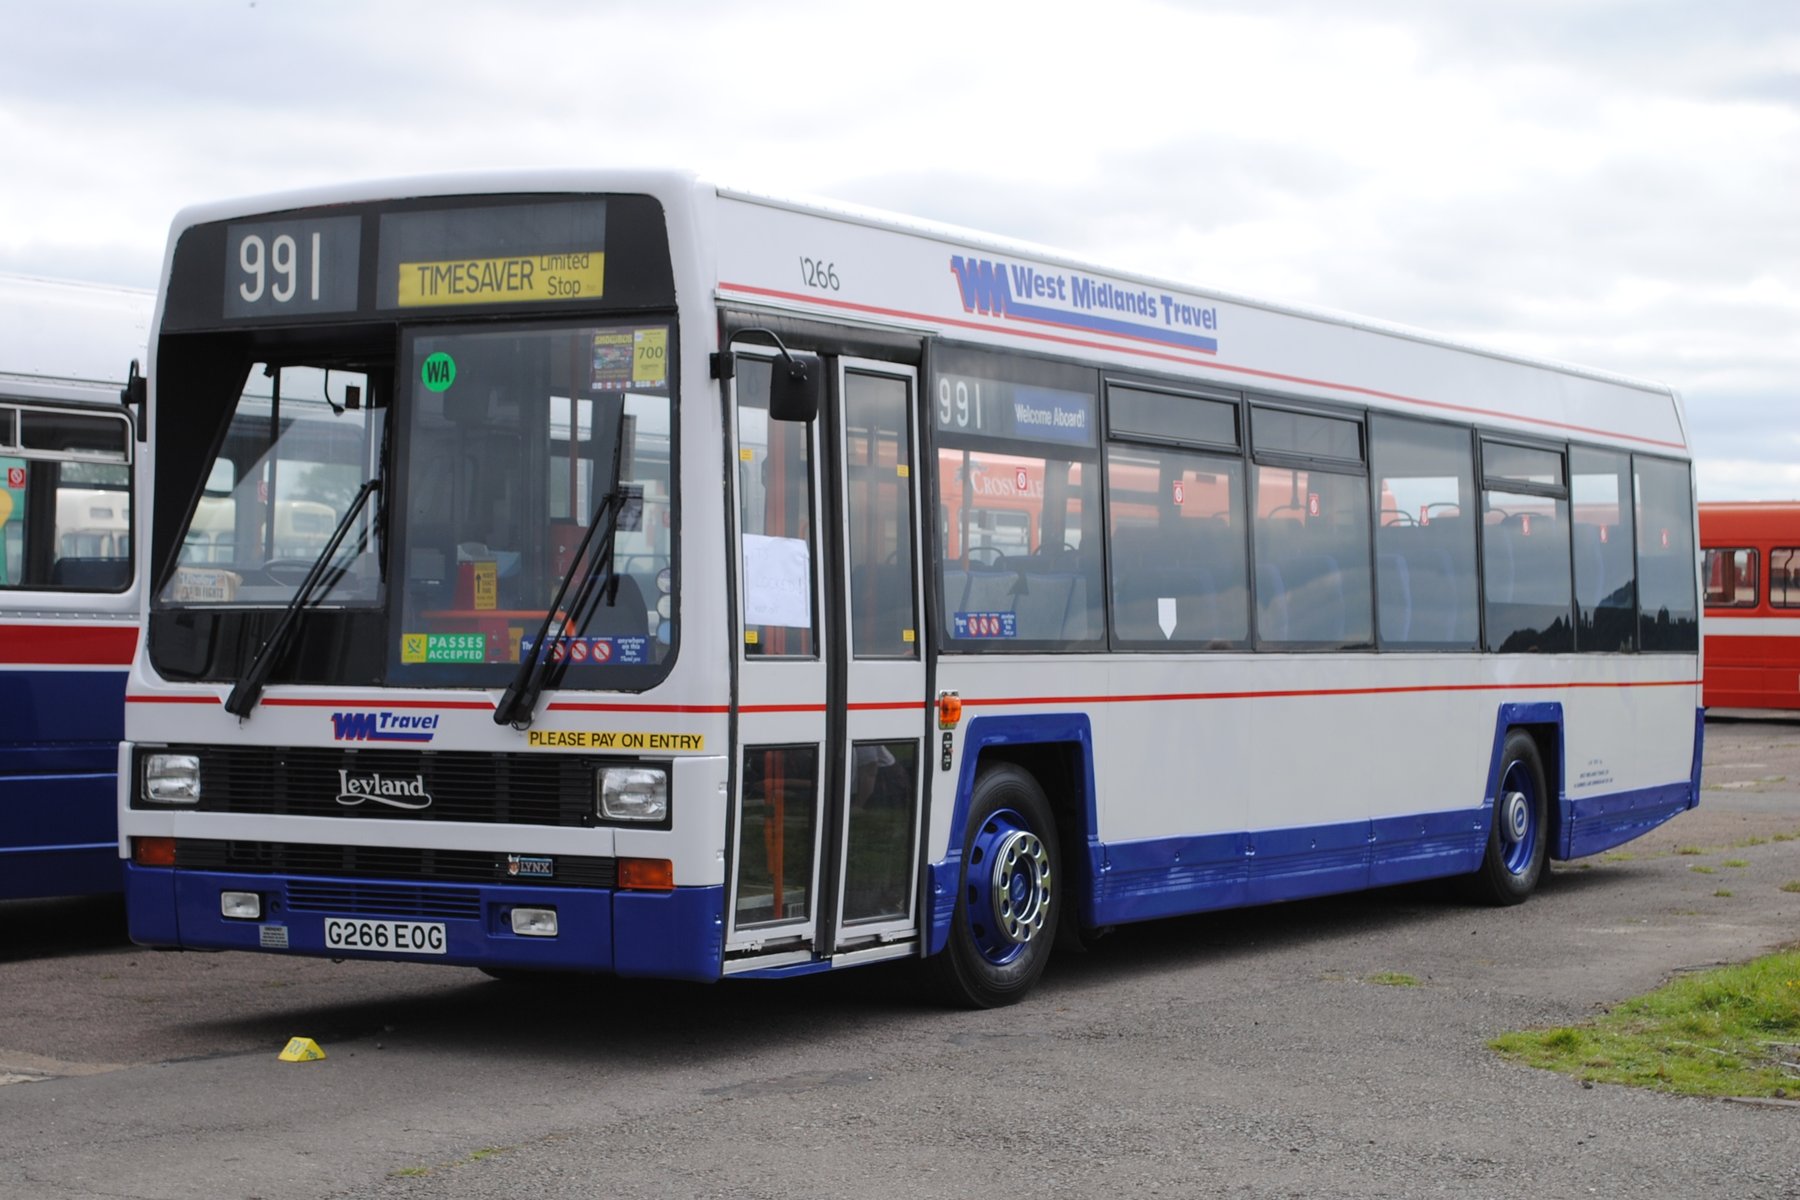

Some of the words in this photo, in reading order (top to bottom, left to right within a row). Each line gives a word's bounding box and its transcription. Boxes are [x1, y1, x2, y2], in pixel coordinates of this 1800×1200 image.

[240, 232, 321, 302] 991
[540, 253, 590, 271] Limited
[417, 259, 534, 296] TIMESAVER
[799, 256, 840, 291] 1266
[547, 276, 581, 298] Stop
[1011, 264, 1066, 301] West
[1071, 275, 1157, 319] Midlands
[1160, 295, 1218, 331] Travel
[638, 346, 664, 359] 700
[427, 361, 450, 383] WA
[939, 377, 981, 429] 991
[1014, 403, 1052, 425] Welcome
[1053, 407, 1086, 428] Aboard!
[428, 637, 483, 649] PASSES
[428, 649, 483, 660] ACCEPTED
[379, 712, 439, 729] Travel
[529, 731, 586, 747] PLEASE
[591, 733, 616, 747] PAY
[621, 733, 644, 748] ON
[650, 734, 702, 749] ENTRY
[336, 769, 432, 809] Leyland
[520, 861, 550, 873] LYNX
[328, 921, 390, 948] G266
[394, 924, 443, 949] EOG
